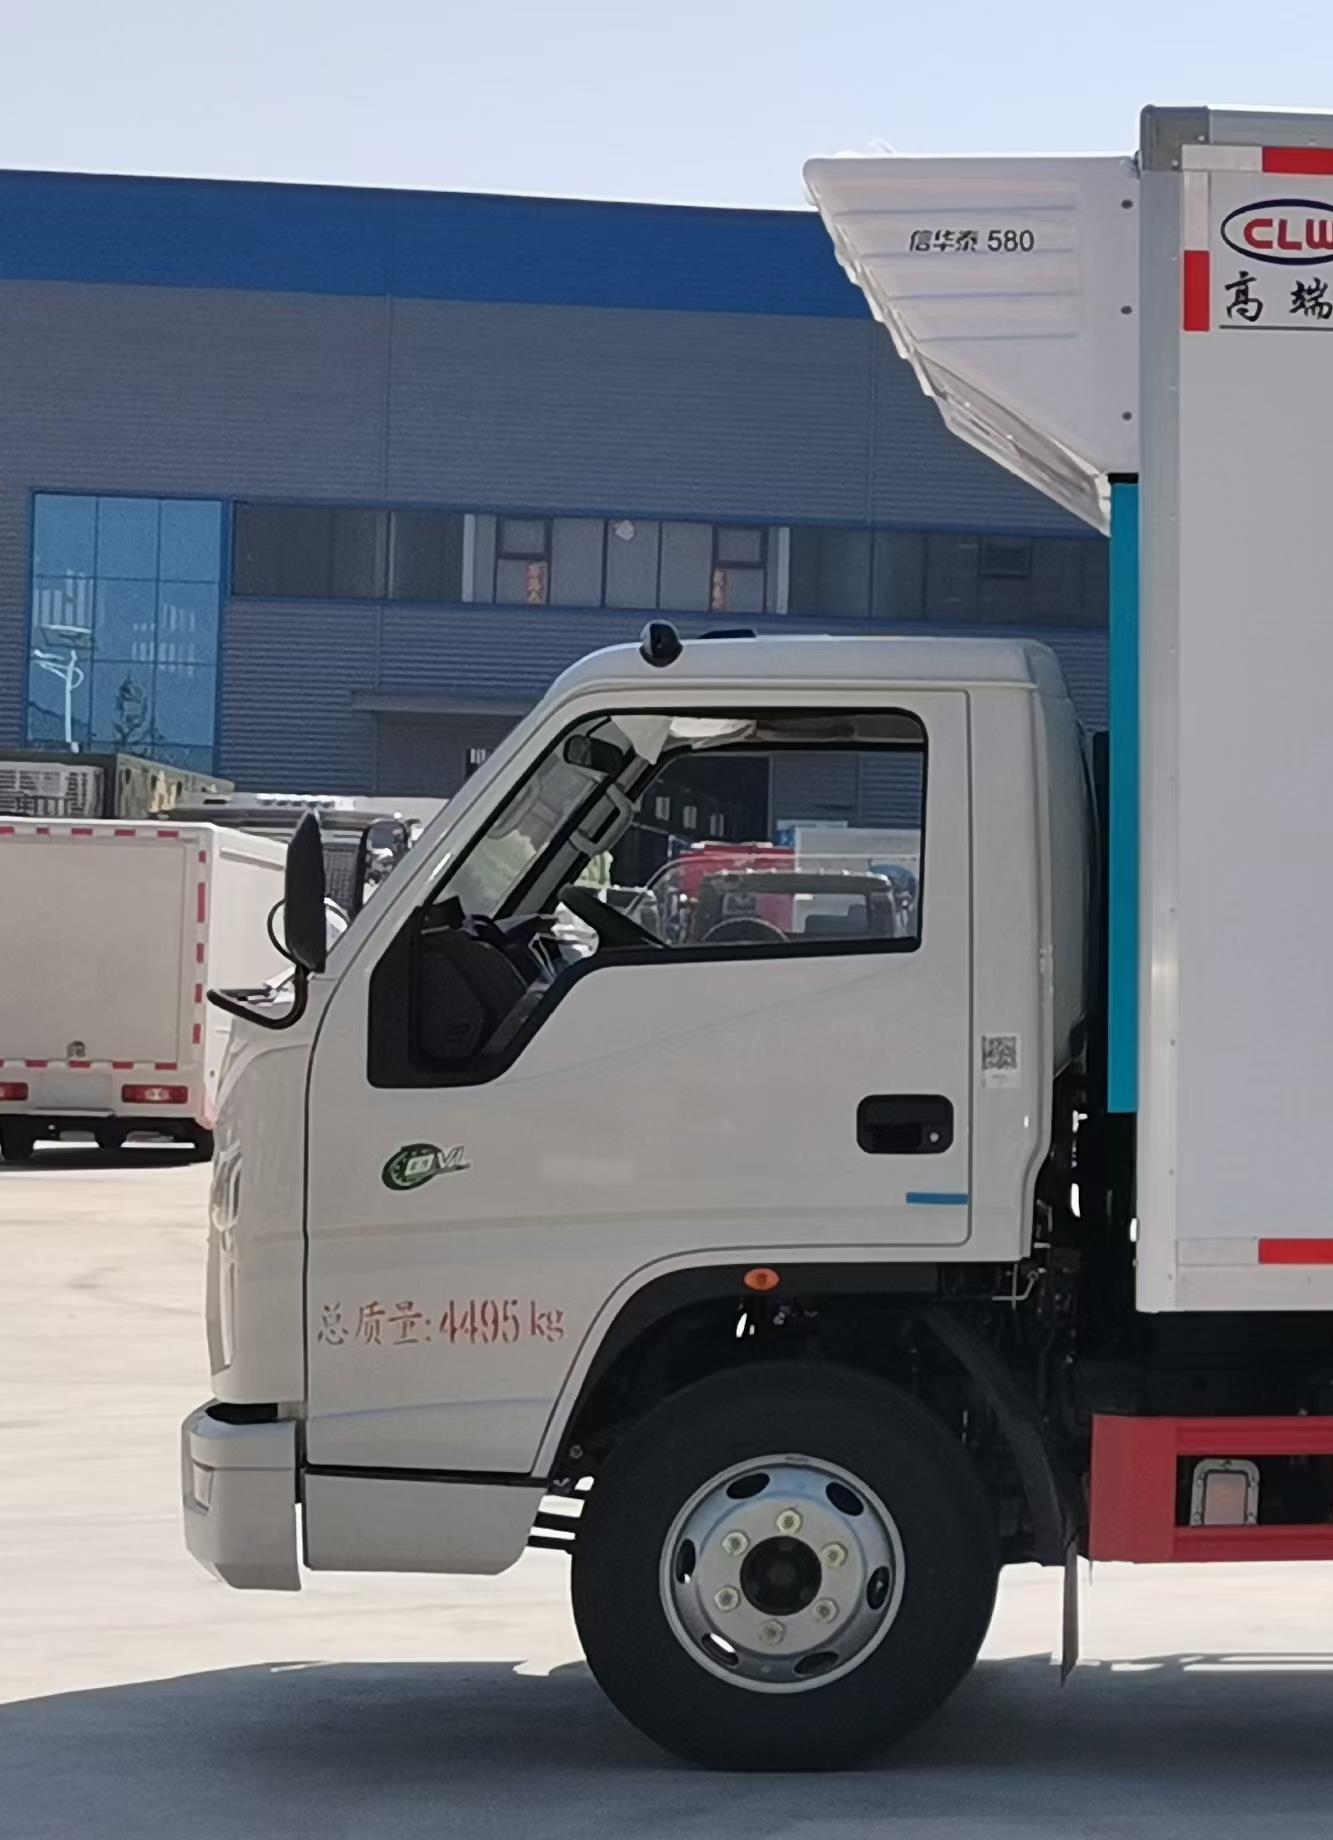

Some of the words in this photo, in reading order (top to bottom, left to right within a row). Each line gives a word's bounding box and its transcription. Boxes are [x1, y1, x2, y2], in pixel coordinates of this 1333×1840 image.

[908, 229, 979, 252] 信华泰
[987, 229, 1035, 252] 580
